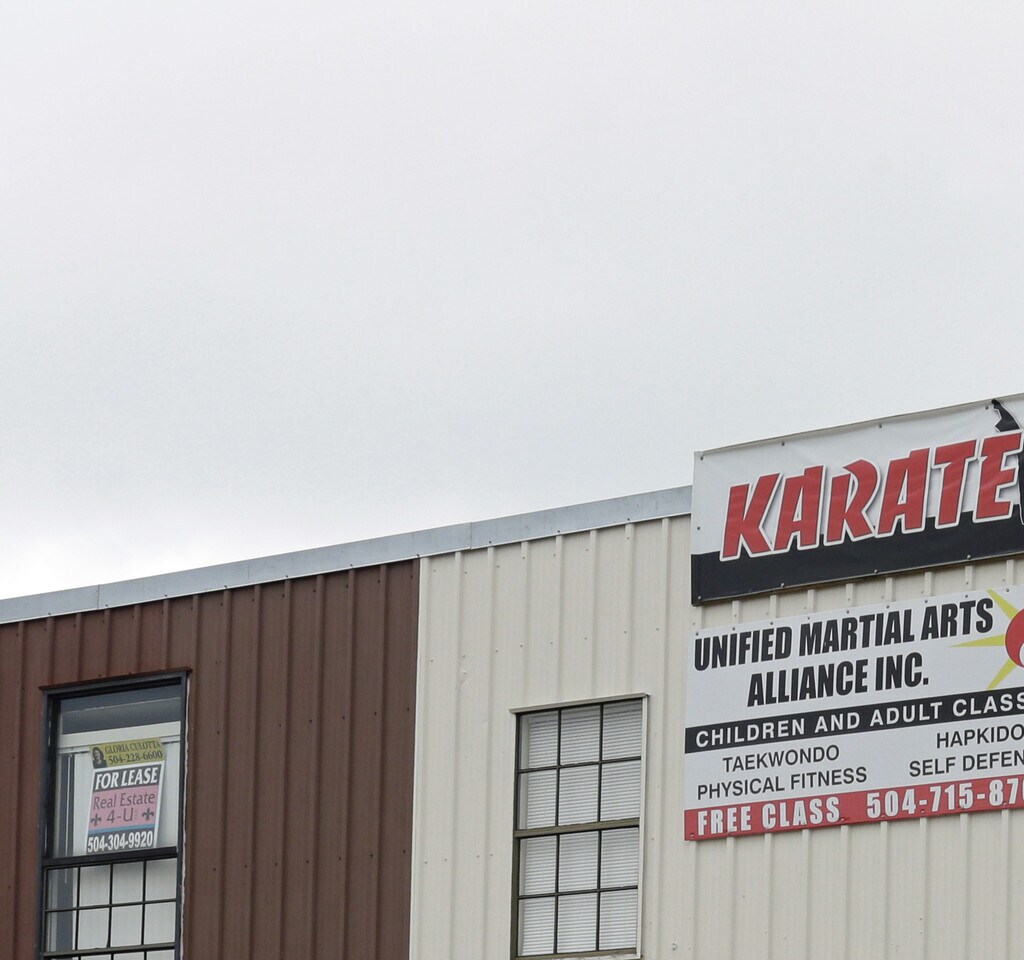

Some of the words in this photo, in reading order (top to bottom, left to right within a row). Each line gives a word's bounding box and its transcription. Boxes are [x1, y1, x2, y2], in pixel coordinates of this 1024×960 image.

[721, 430, 1024, 560] KARATE
[694, 626, 792, 671] UNIFIED
[799, 610, 914, 657] MARTIAL
[921, 597, 993, 641] ARTS
[747, 658, 868, 707] ALLIANCE
[875, 652, 929, 691] INC.
[696, 720, 805, 748] CHILDREN
[815, 711, 860, 733] AND
[869, 701, 942, 727] ADULT
[936, 723, 1024, 749] HAPKIDO
[105, 744, 129, 755] GLORIA
[130, 740, 161, 752] CULOTTA
[109, 751, 163, 765] 504-228-6600
[723, 745, 840, 773] TAEKWONDO
[95, 771, 119, 790] FOR
[121, 767, 159, 787] LEASE
[909, 756, 956, 777] SELF
[698, 776, 785, 800] PHYSICAL
[790, 766, 867, 791] FITNESS
[93, 794, 117, 810] Real
[120, 792, 156, 806] Estate
[106, 808, 134, 823] 4-U
[698, 807, 752, 835] FREE
[762, 797, 840, 828] CLASS
[88, 831, 153, 853] 504-304-9920
